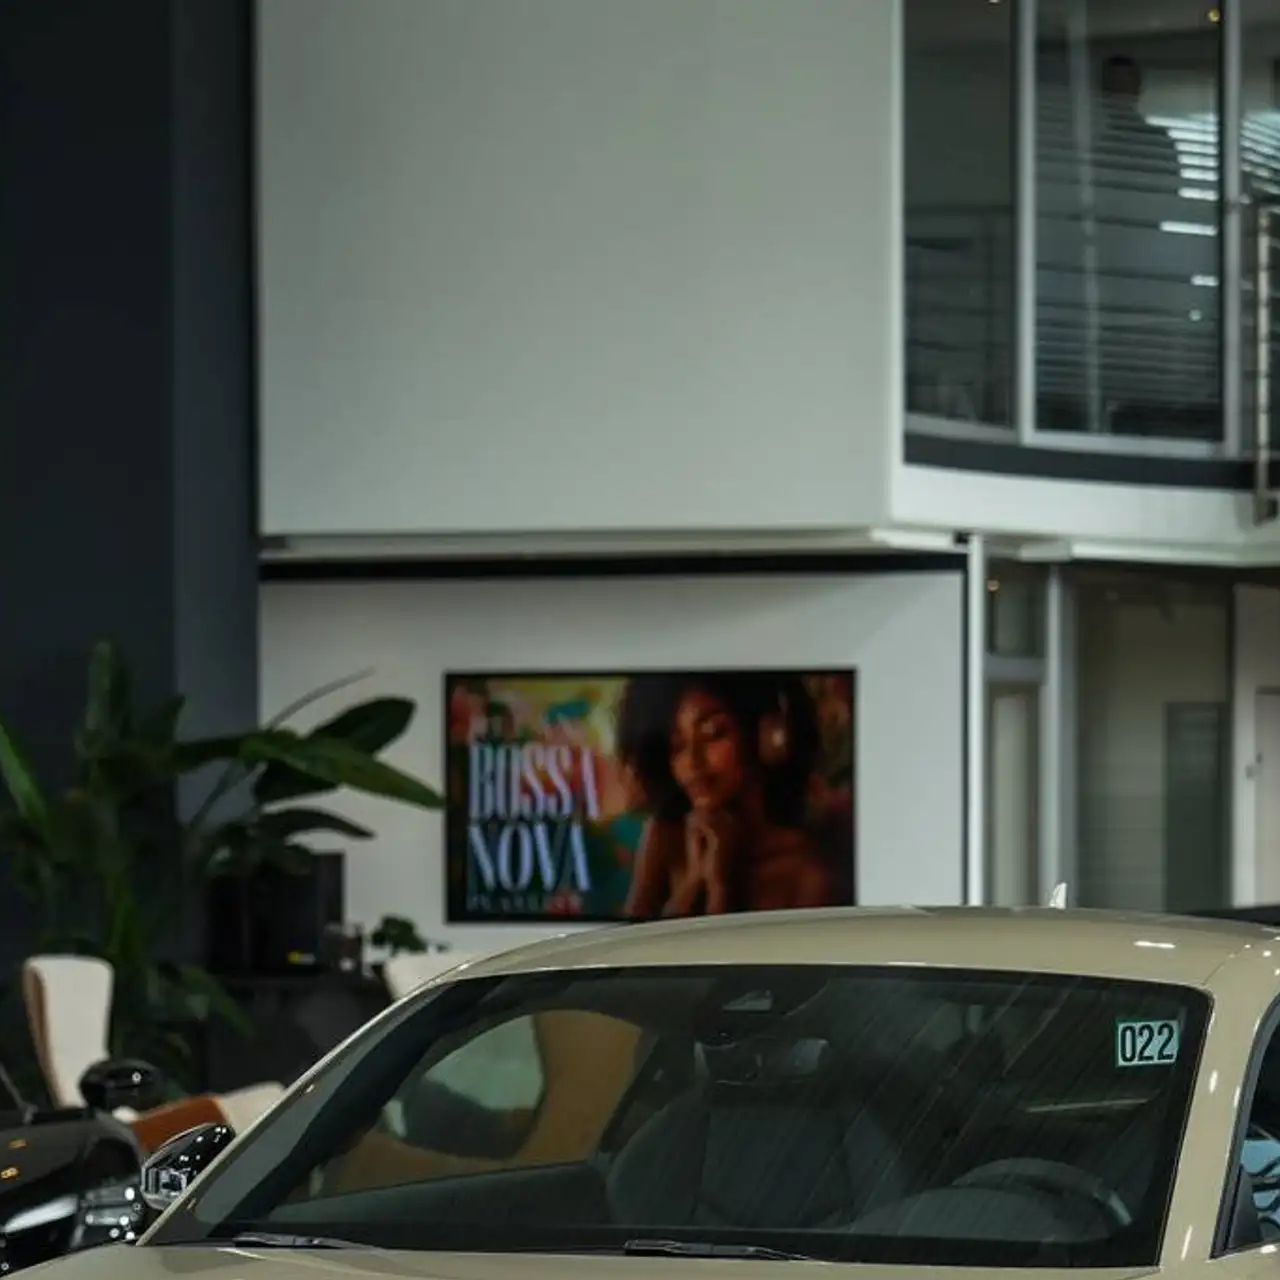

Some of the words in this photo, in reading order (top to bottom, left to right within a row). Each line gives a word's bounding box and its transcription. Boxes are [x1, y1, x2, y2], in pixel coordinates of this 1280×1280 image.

[468, 742, 601, 821] BOSSA
[468, 822, 593, 892] NOVA
[1120, 1023, 1174, 1062] 022
